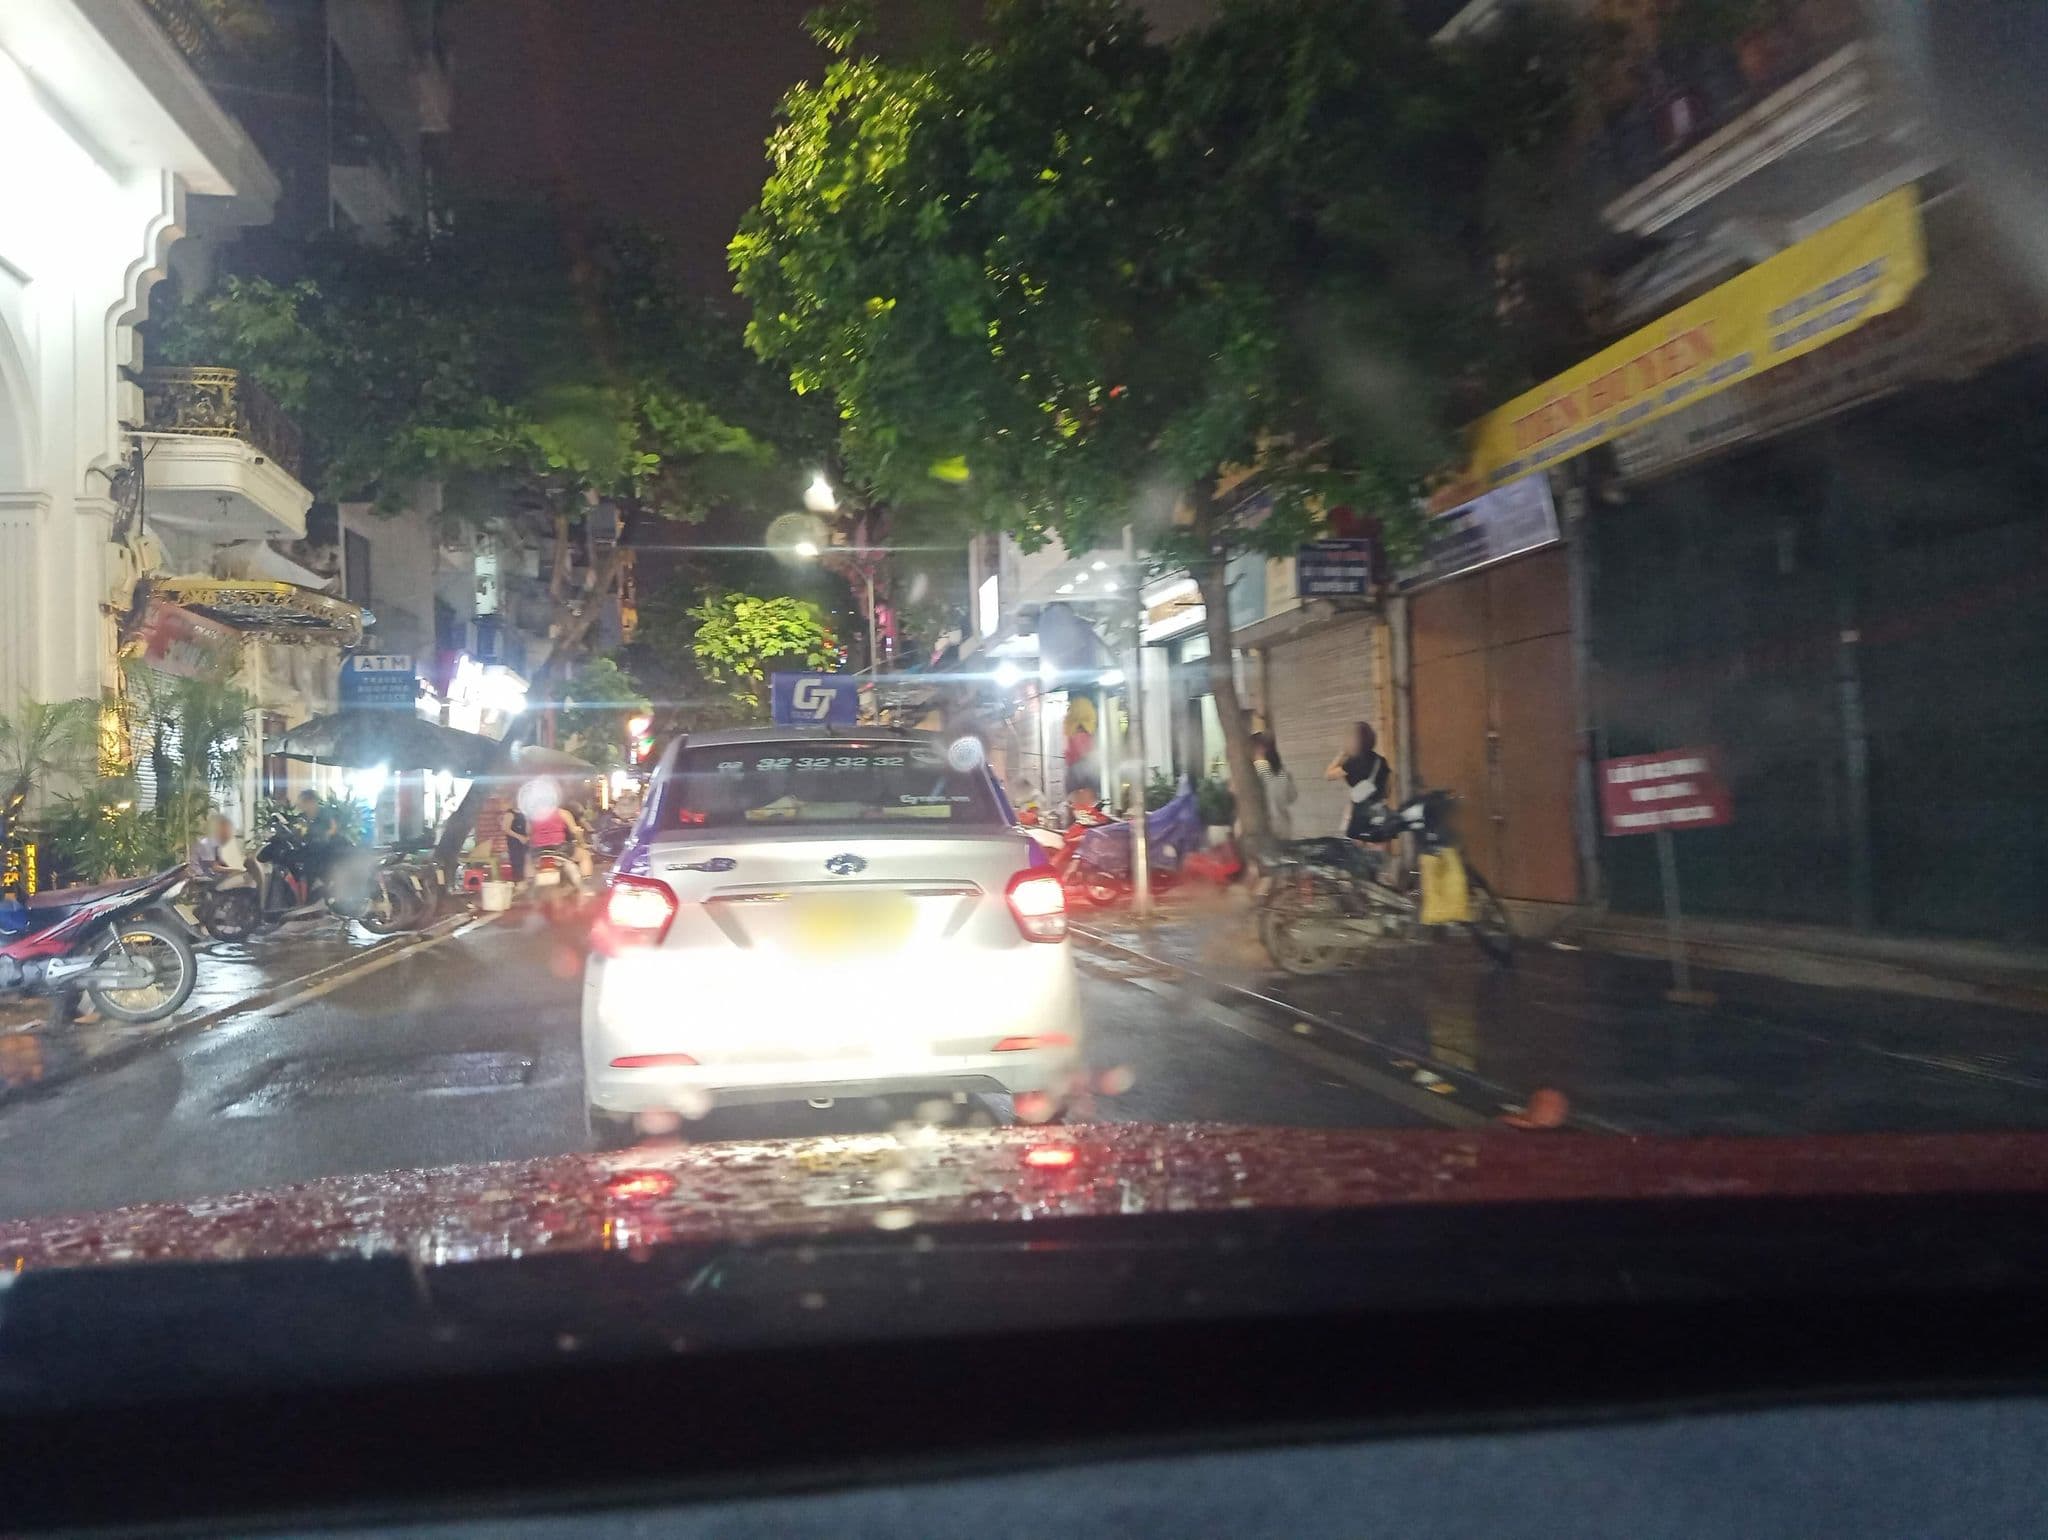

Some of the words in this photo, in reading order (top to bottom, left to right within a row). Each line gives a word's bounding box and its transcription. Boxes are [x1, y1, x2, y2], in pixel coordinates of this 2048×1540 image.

[360, 657, 406, 670] ATM
[792, 678, 838, 720] G7
[756, 758, 793, 770] 32
[795, 757, 831, 769] 32
[835, 757, 868, 767] 32
[872, 757, 905, 767] 32
[26, 844, 36, 896] MASS
